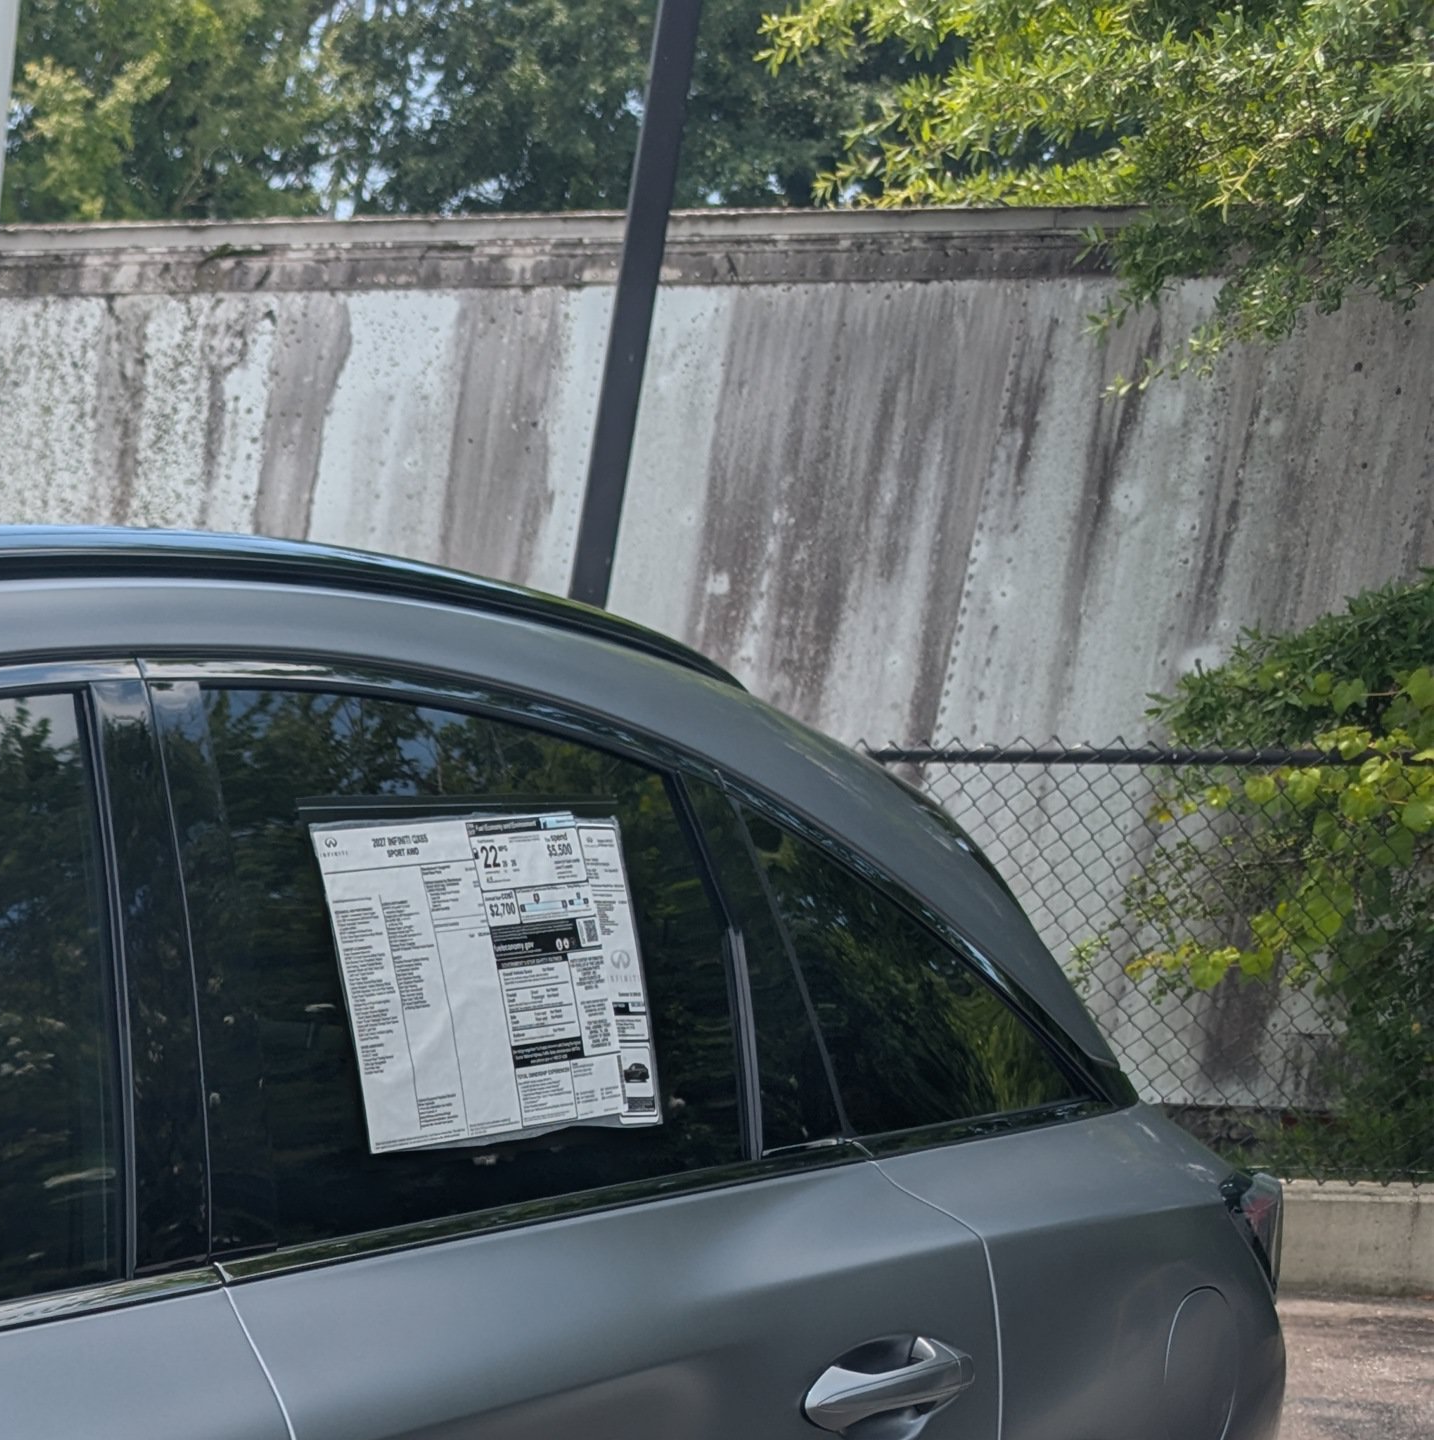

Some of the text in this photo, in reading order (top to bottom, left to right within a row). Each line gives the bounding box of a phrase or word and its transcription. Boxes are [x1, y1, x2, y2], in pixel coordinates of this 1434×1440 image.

[550, 832, 568, 842] spend
[386, 849, 406, 858] SPORT
[480, 845, 501, 869] 22
[546, 843, 573, 858] $5,500
[489, 902, 516, 918] $2,700
